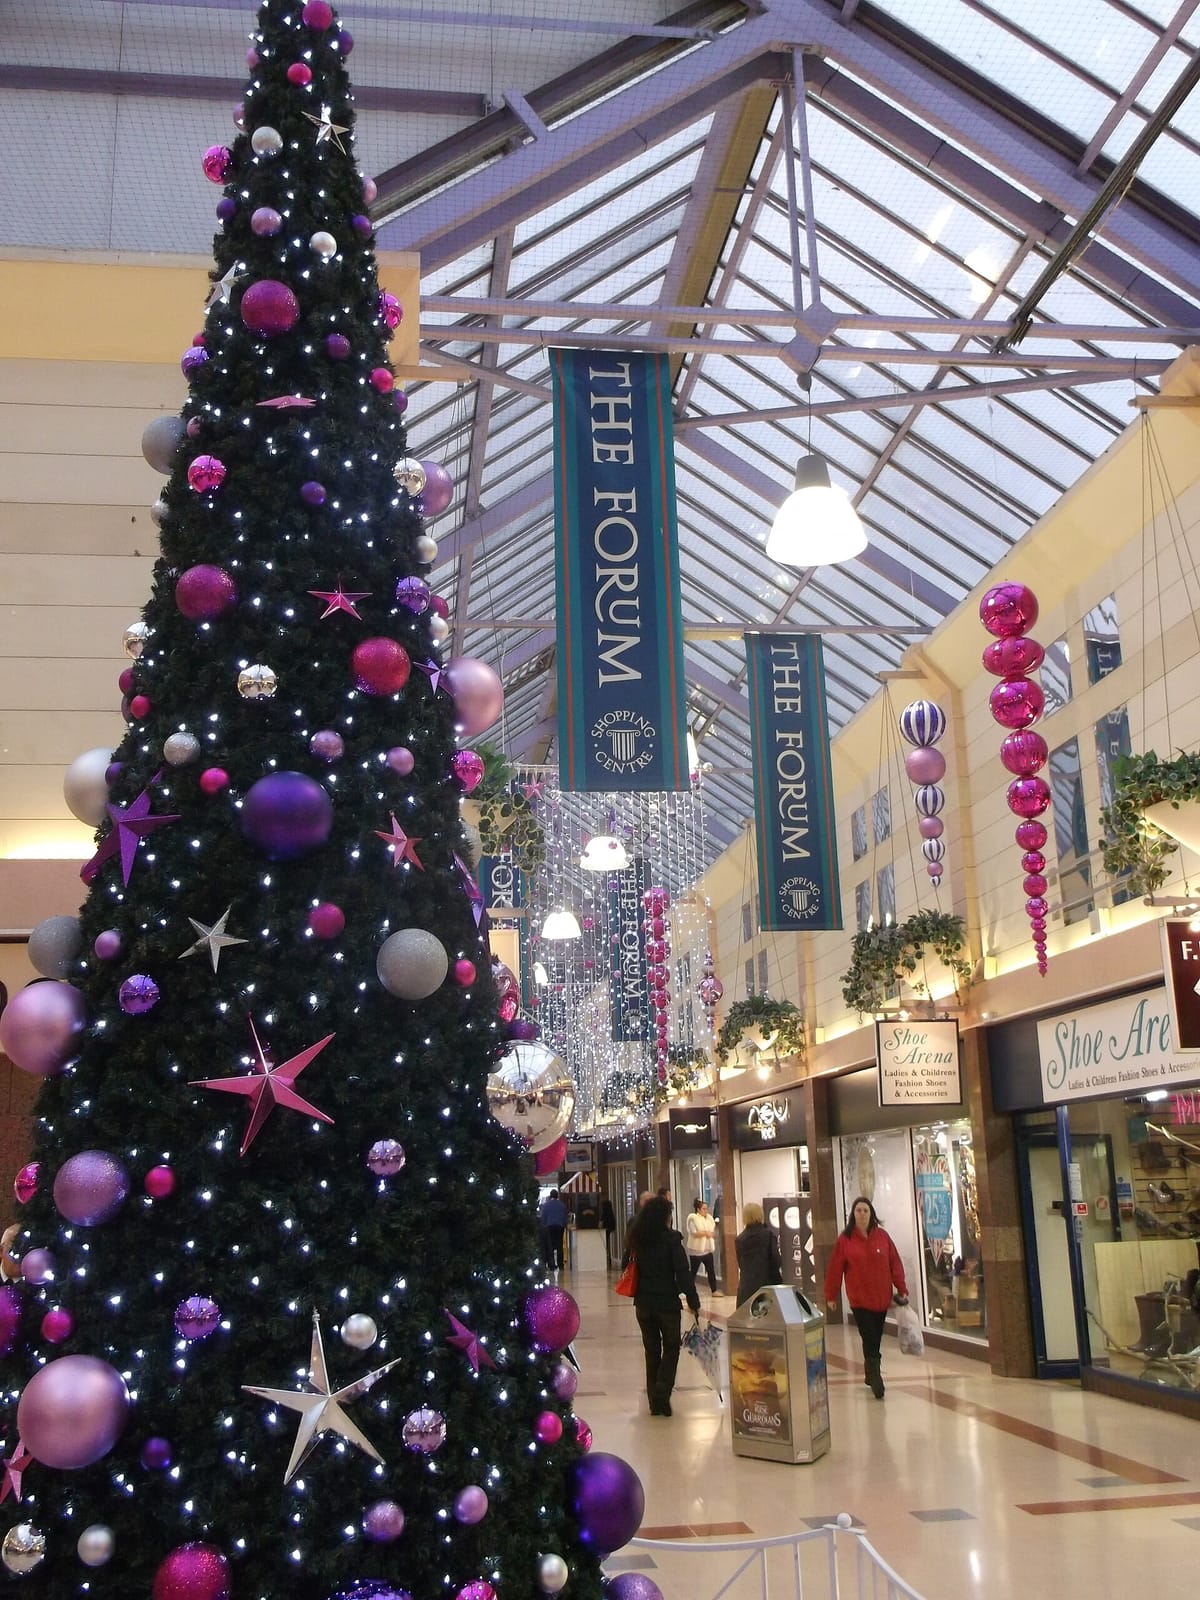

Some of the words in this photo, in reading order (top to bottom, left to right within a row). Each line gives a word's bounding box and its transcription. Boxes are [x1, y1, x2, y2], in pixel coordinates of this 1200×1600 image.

[589, 362, 635, 465] THE
[593, 486, 642, 689] FORUM
[770, 642, 802, 714] THE
[591, 710, 656, 739] SHOPPING
[595, 750, 654, 775] CENTRE
[775, 729, 811, 863] FORUM
[778, 876, 821, 897] SHOPPING
[781, 902, 820, 920] CENTRE
[622, 919, 642, 999] FORUM
[1181, 940, 1200, 960] F.
[884, 1027, 928, 1051] Shoe
[1046, 1019, 1103, 1090] Shoe
[1108, 999, 1171, 1061] Are
[893, 1046, 953, 1065] Arena
[884, 1069, 909, 1077] Ladies
[911, 1069, 918, 1077] &
[920, 1068, 957, 1077] Childrens
[895, 1079, 923, 1087] Fashion
[925, 1079, 947, 1087] Shoes
[1118, 1070, 1140, 1082] Fashion
[1141, 1067, 1159, 1079] Shoes
[1160, 1063, 1166, 1075] &
[894, 1090, 901, 1098] &
[904, 1089, 948, 1098] Accessories
